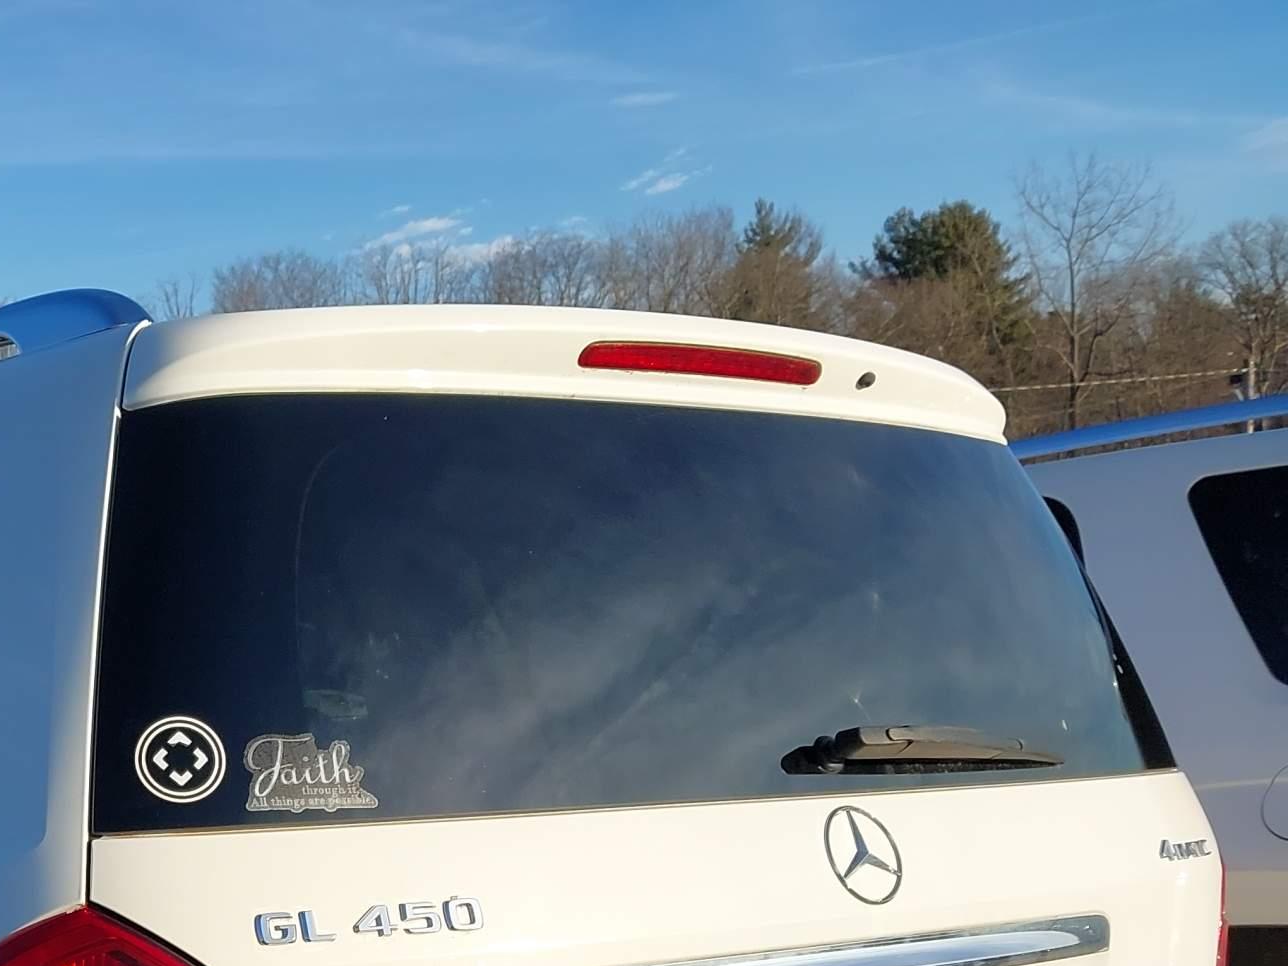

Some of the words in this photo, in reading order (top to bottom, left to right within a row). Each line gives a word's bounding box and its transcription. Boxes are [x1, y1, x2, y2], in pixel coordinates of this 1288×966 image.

[247, 736, 361, 797] Faith
[251, 797, 268, 807] All
[271, 796, 305, 809] things
[308, 798, 326, 806] are
[302, 784, 344, 798] through
[254, 911, 336, 945] GL
[352, 896, 484, 937] 450
